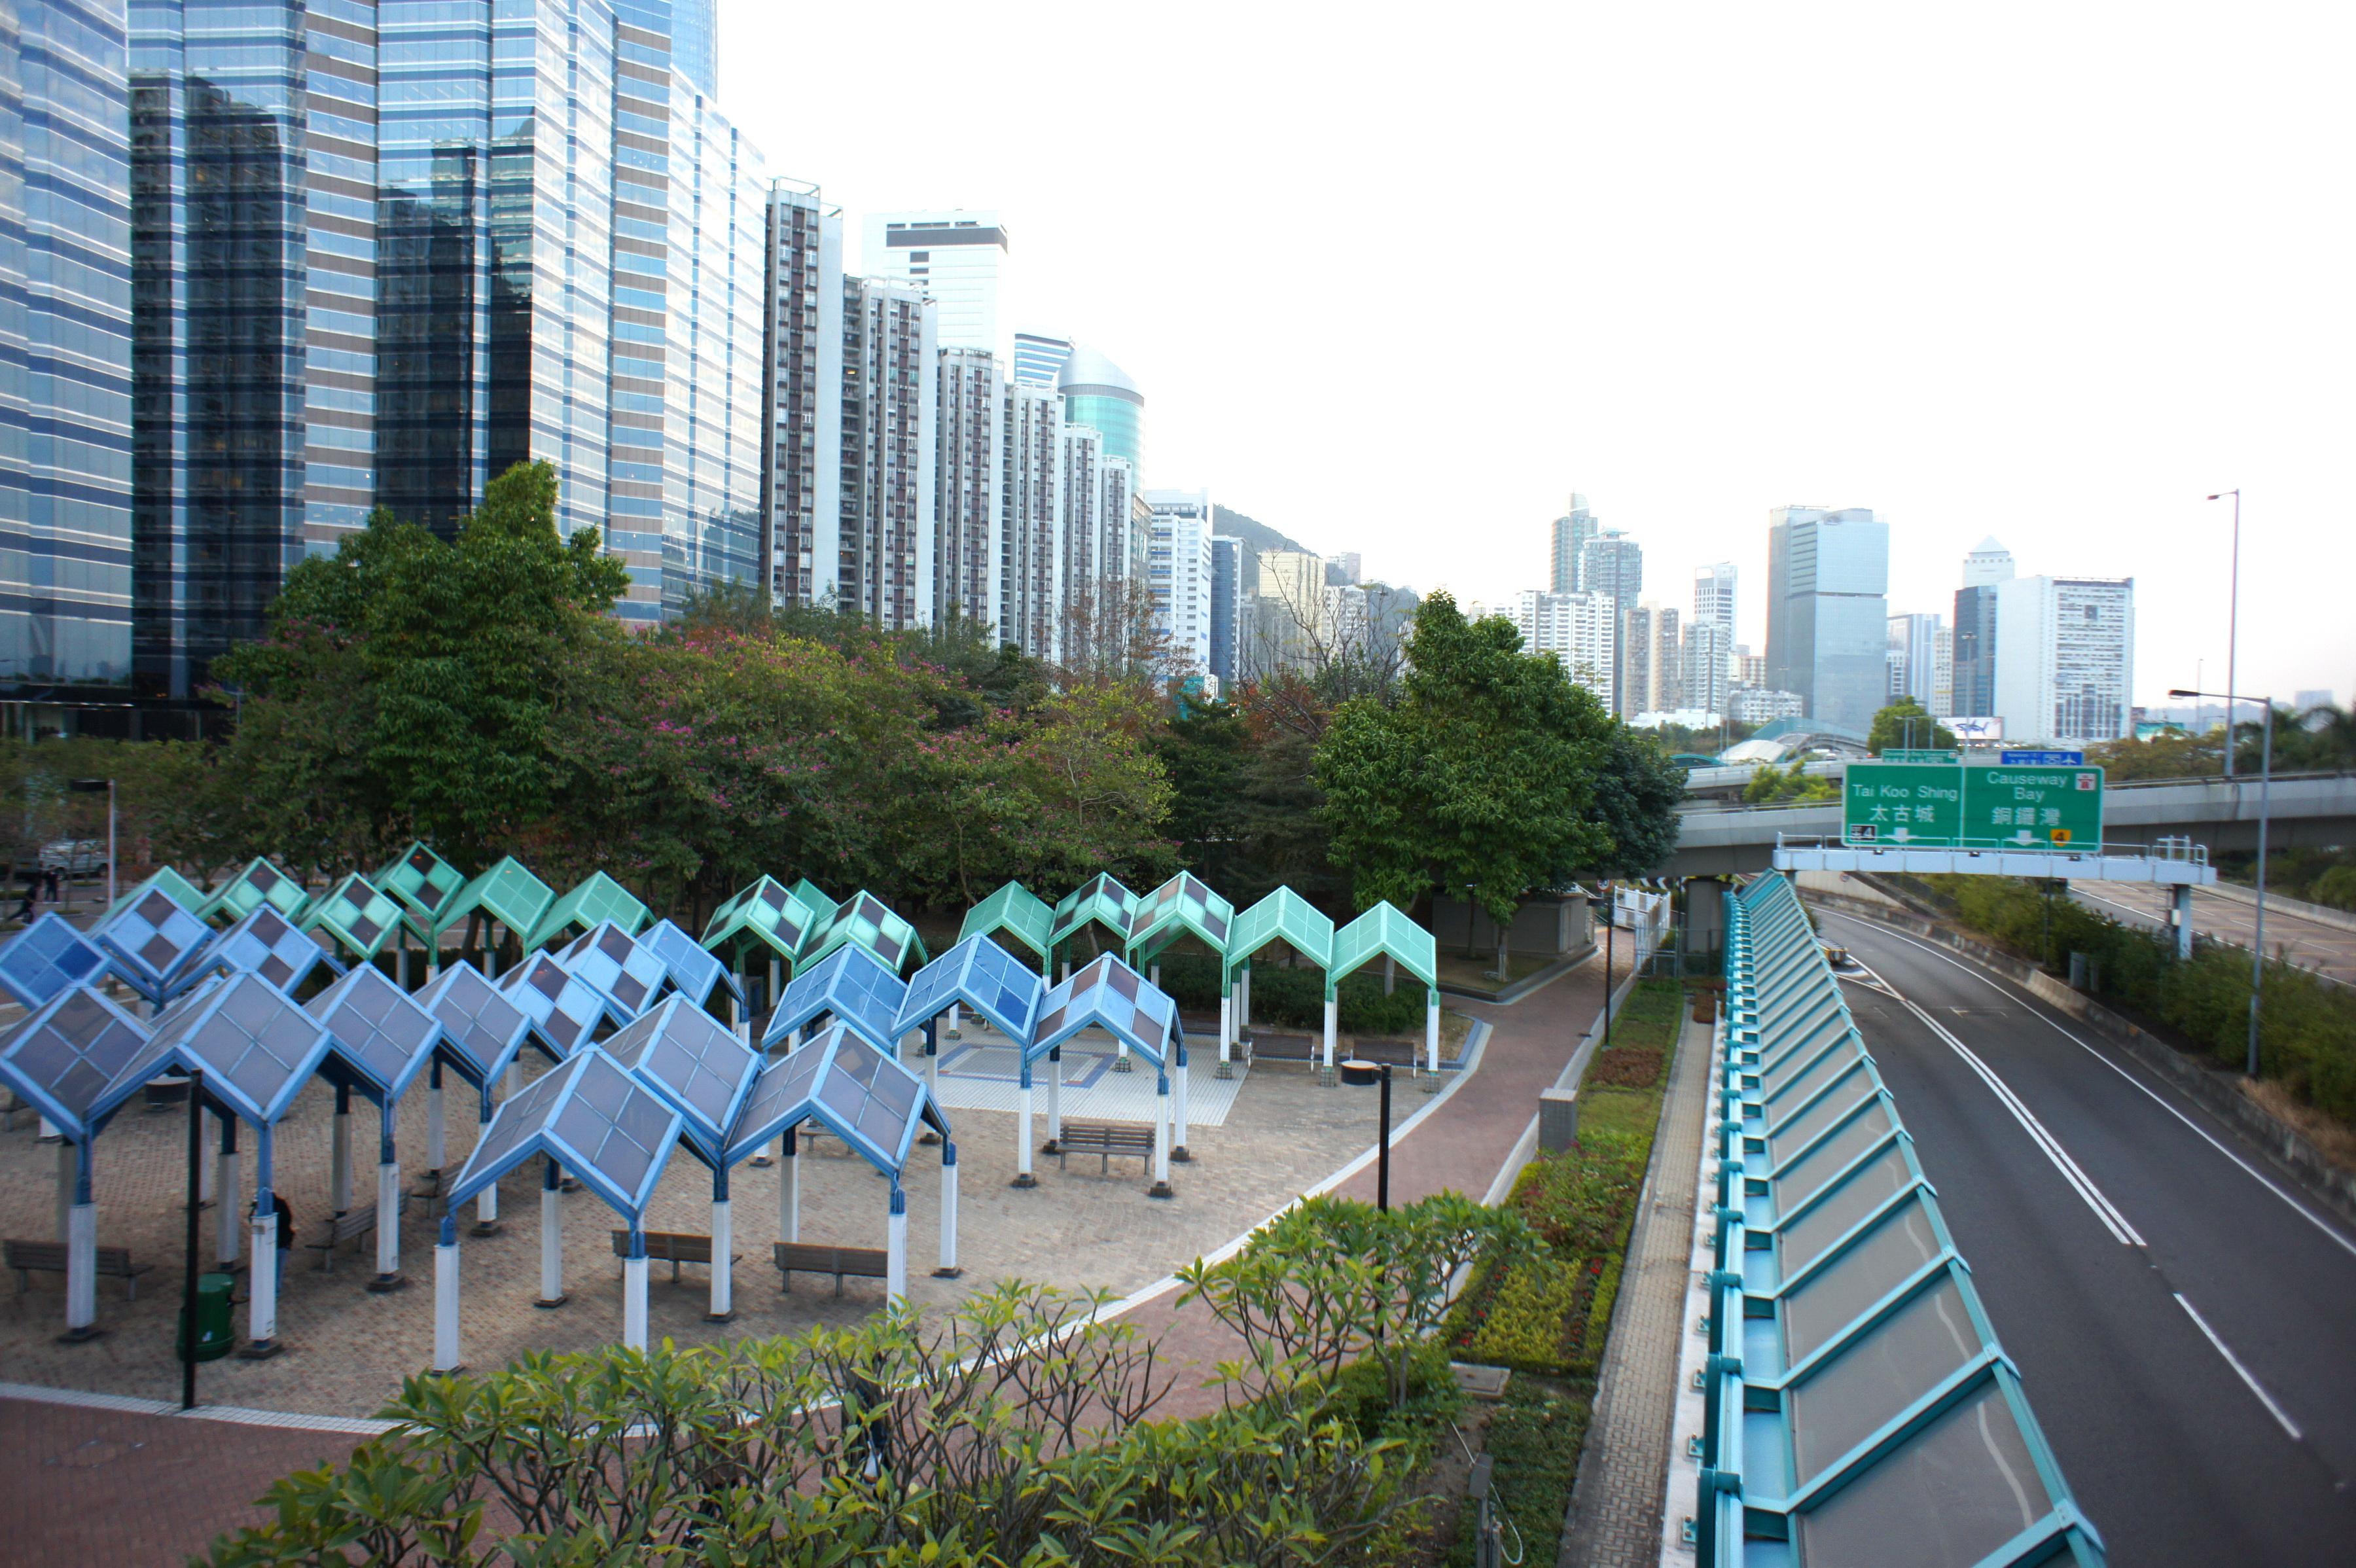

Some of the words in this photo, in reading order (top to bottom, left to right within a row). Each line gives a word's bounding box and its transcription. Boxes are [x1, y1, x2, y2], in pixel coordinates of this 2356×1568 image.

[1987, 772, 2067, 788] Causeway
[1852, 784, 1874, 797] Tai
[1880, 785, 1910, 797] Koo
[1918, 785, 1958, 802] Shing
[2014, 787, 2045, 802] Bay
[1869, 804, 1935, 823] 太古城
[1863, 827, 1873, 838] 4
[2054, 832, 2065, 842] 4
